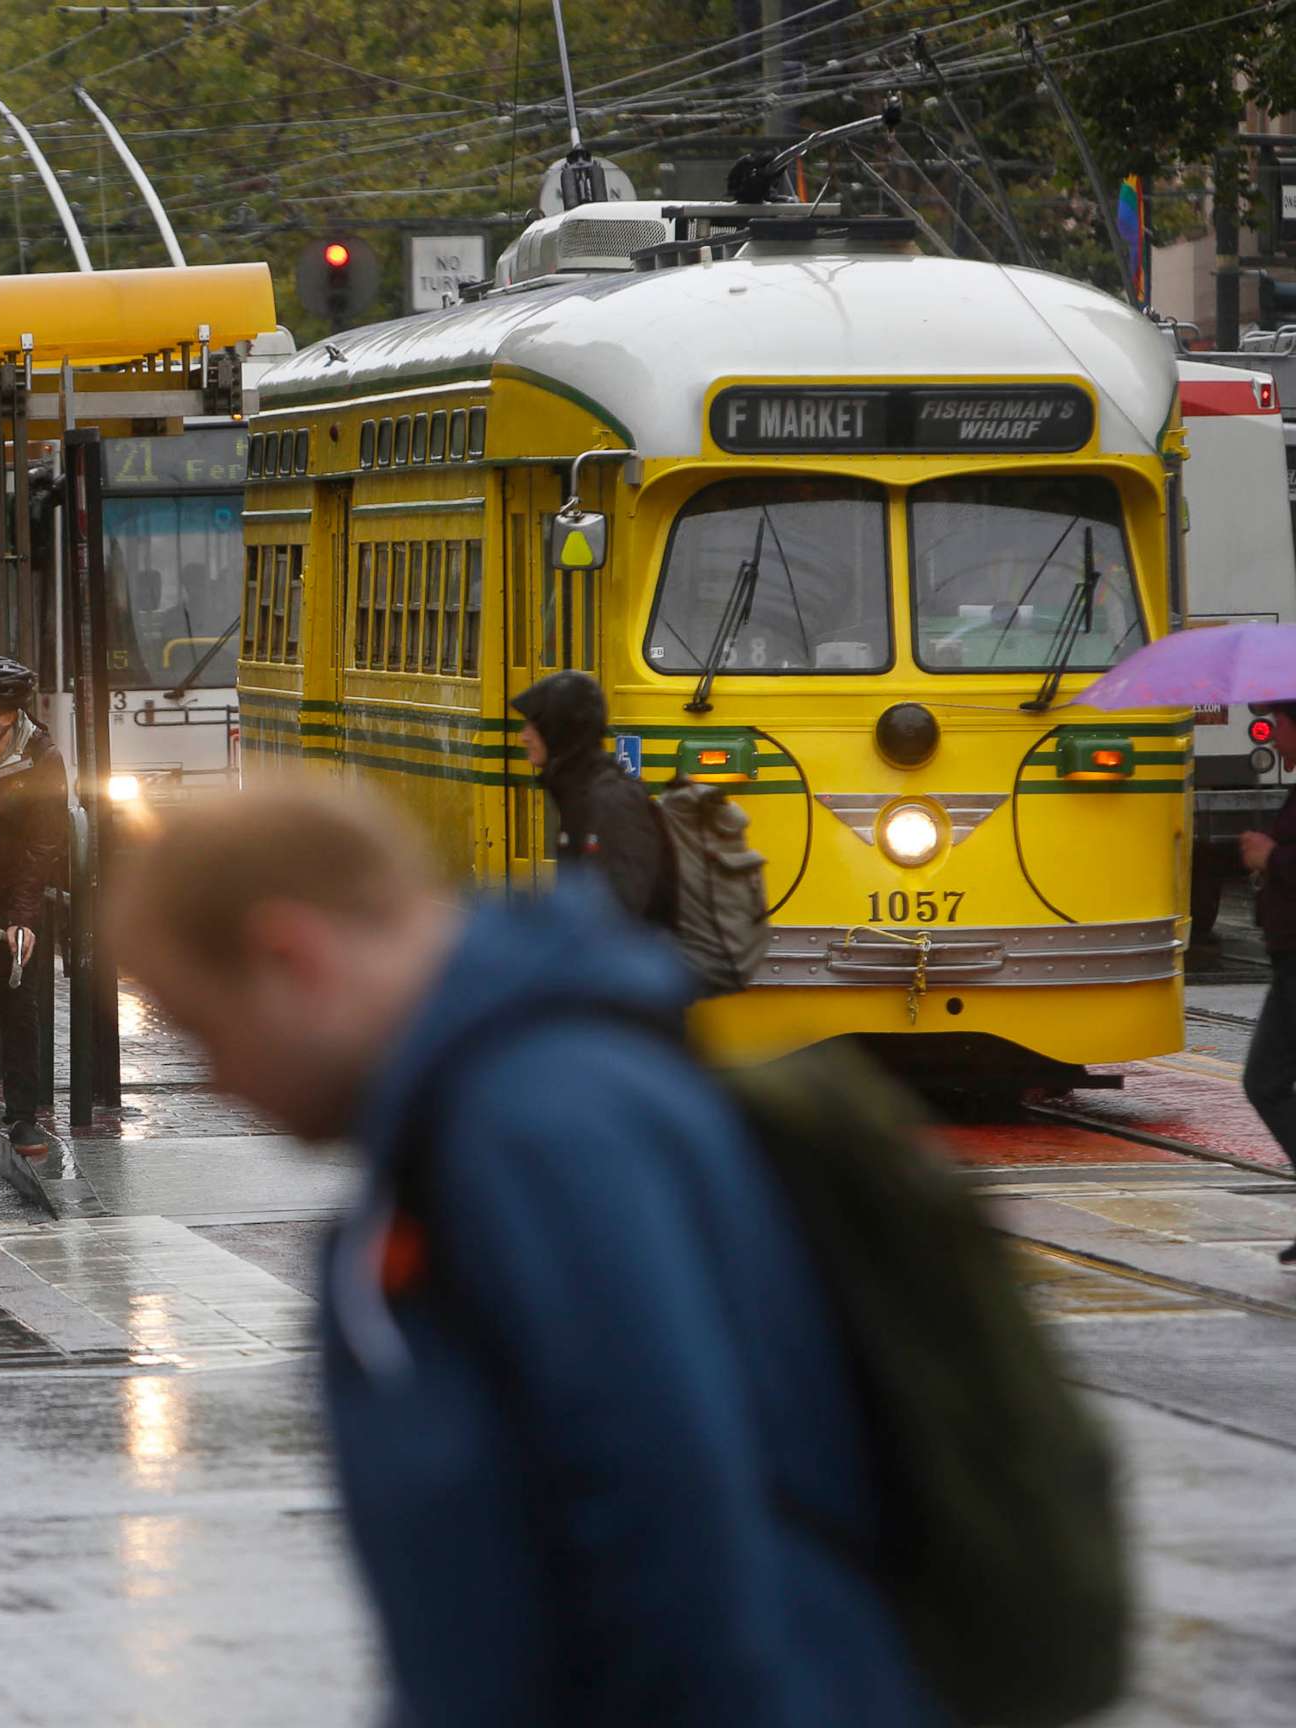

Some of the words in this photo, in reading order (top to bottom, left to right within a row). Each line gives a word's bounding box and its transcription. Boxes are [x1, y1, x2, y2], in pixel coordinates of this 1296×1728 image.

[435, 255, 460, 271] NO
[728, 401, 747, 437] F
[760, 401, 867, 437] MARKET
[920, 401, 1077, 419] FISHERMAN'S
[960, 421, 1041, 439] WHARF
[114, 439, 159, 481] 21
[868, 890, 966, 922] 1057
